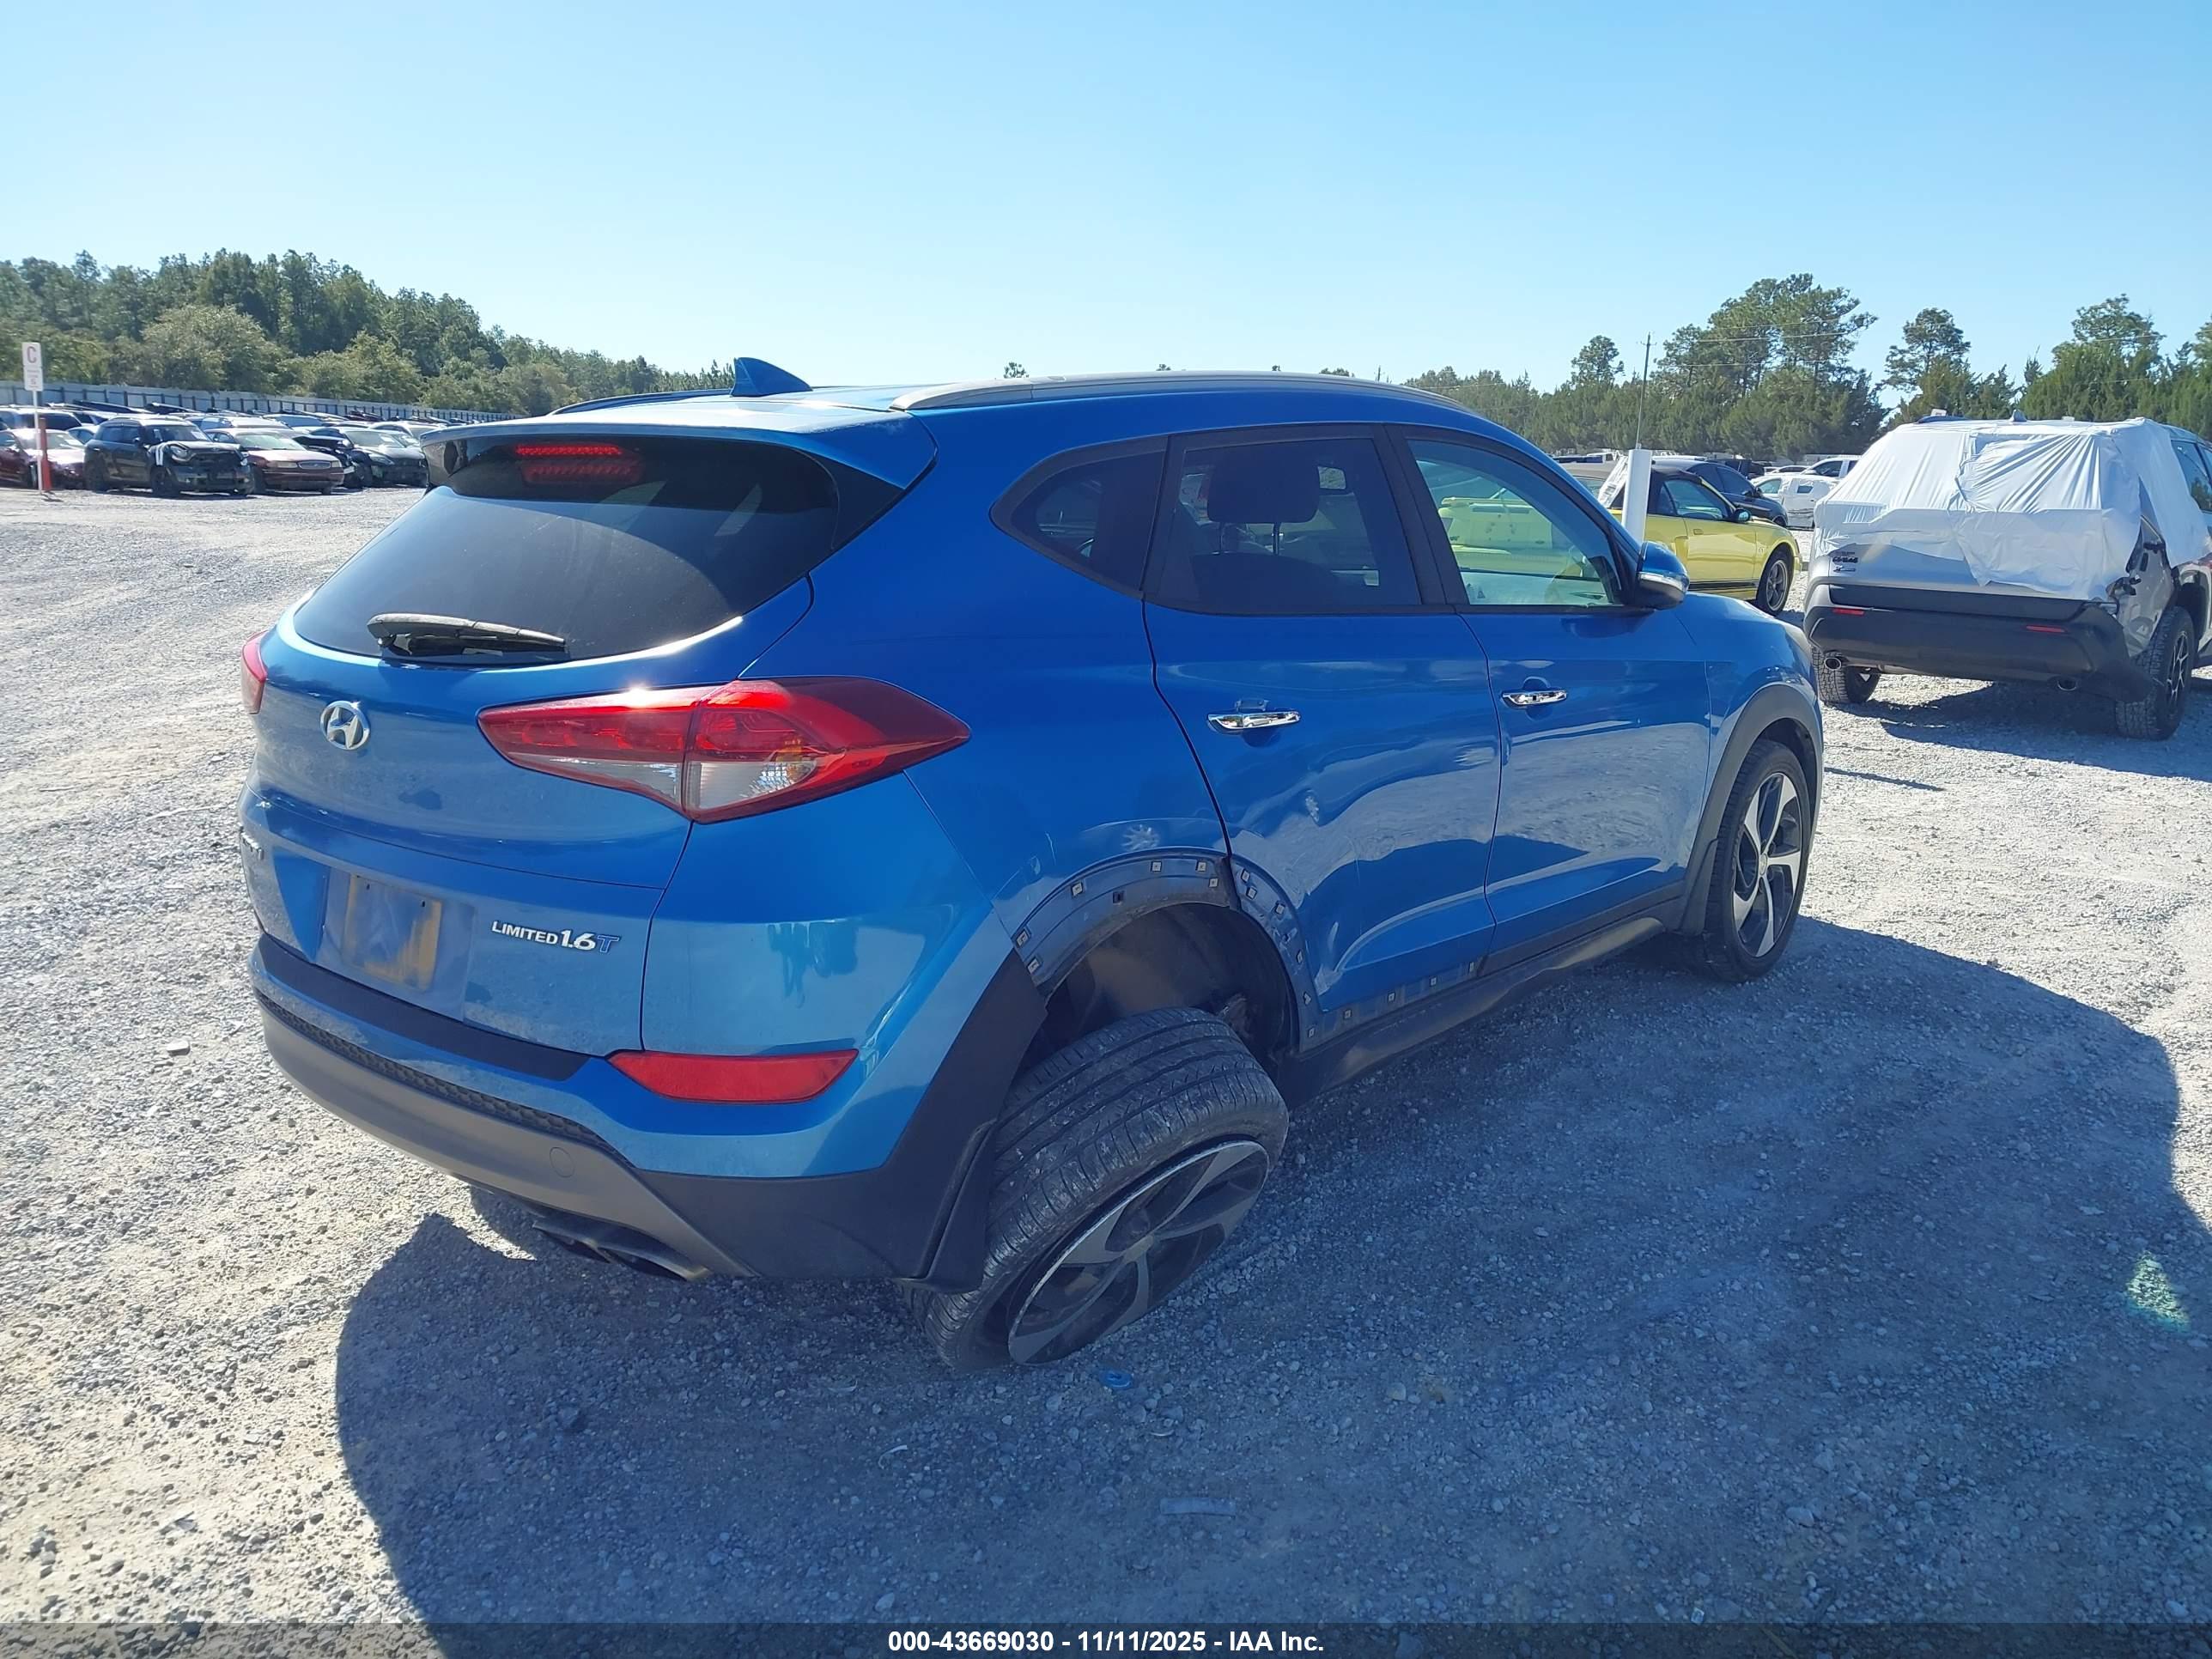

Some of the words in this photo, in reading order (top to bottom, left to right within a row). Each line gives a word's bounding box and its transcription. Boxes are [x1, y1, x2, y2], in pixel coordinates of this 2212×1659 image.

[27, 346, 37, 363] C
[491, 920, 558, 945] LIMITED
[560, 929, 620, 953] 1.6T
